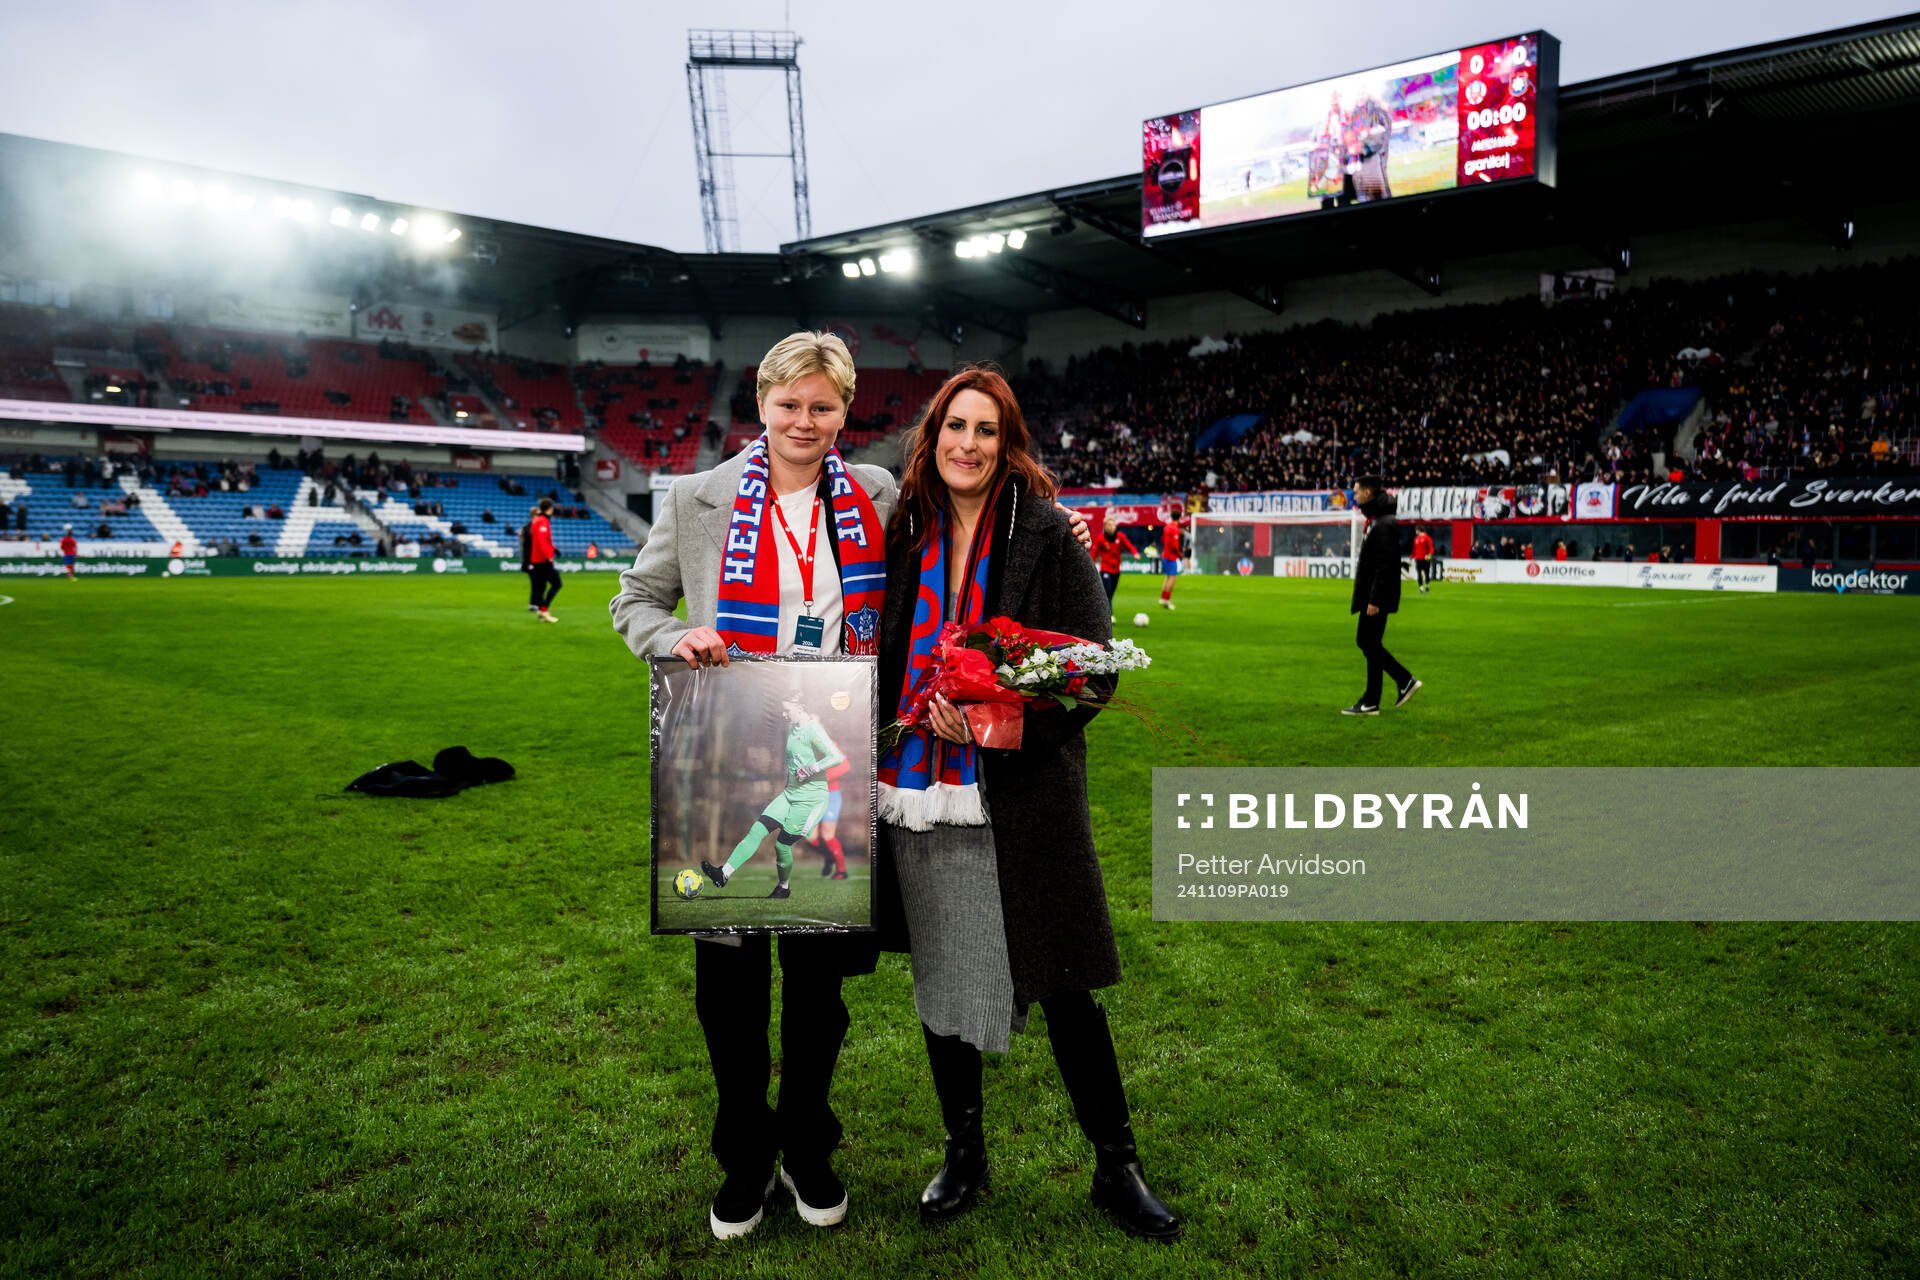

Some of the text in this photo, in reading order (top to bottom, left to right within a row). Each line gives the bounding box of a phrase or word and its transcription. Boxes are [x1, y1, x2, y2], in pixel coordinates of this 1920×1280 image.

[1470, 45, 1527, 74] 0 0
[1467, 102, 1527, 130] 00:00
[1622, 482, 1690, 510] Vila
[1699, 488, 1714, 504] i
[1713, 482, 1788, 514] frid
[834, 506, 868, 548] IF
[1542, 565, 1596, 577] AllOffice
[1811, 568, 1908, 590] kondektor
